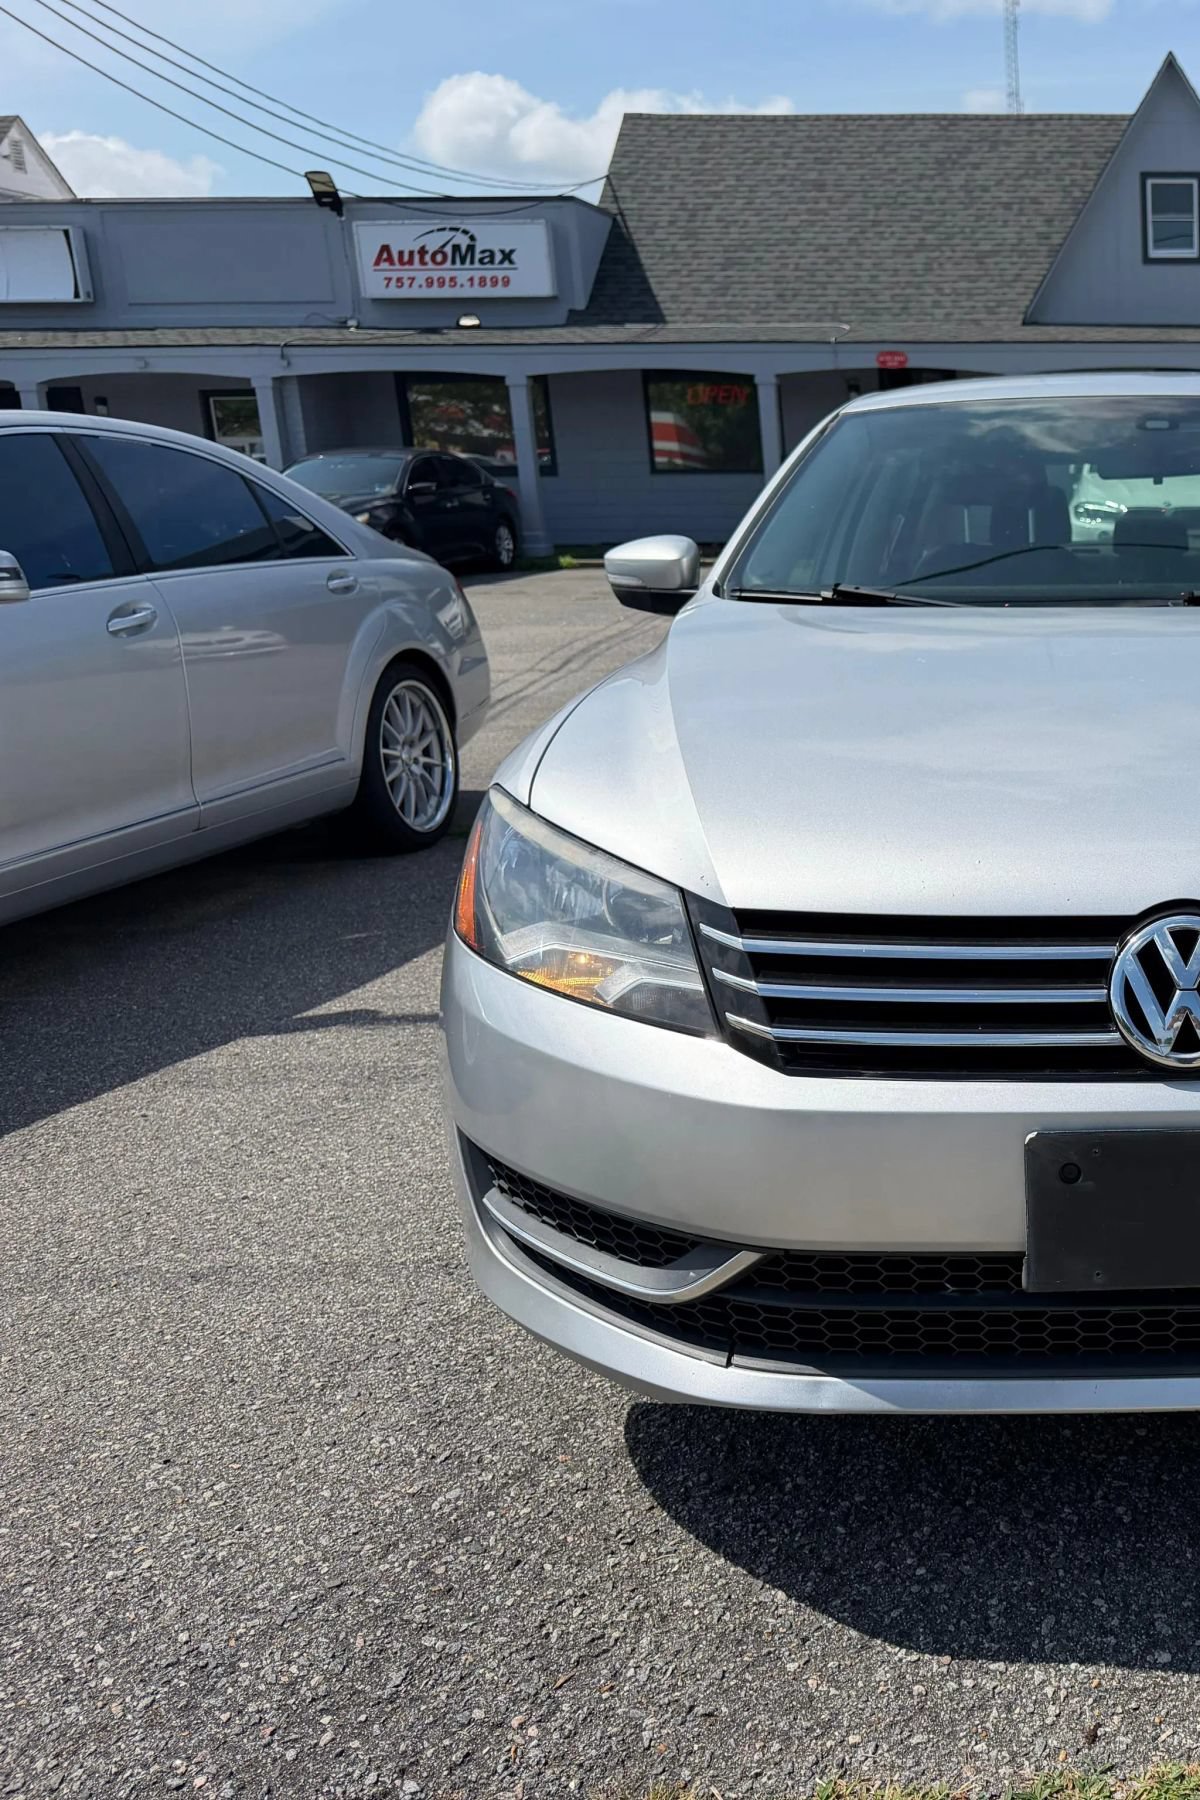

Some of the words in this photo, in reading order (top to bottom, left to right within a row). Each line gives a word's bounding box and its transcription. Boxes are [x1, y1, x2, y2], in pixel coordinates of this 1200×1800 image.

[373, 244, 517, 267] AutoMax
[383, 276, 512, 289] 757.995.1899
[687, 384, 748, 405] OPEN
